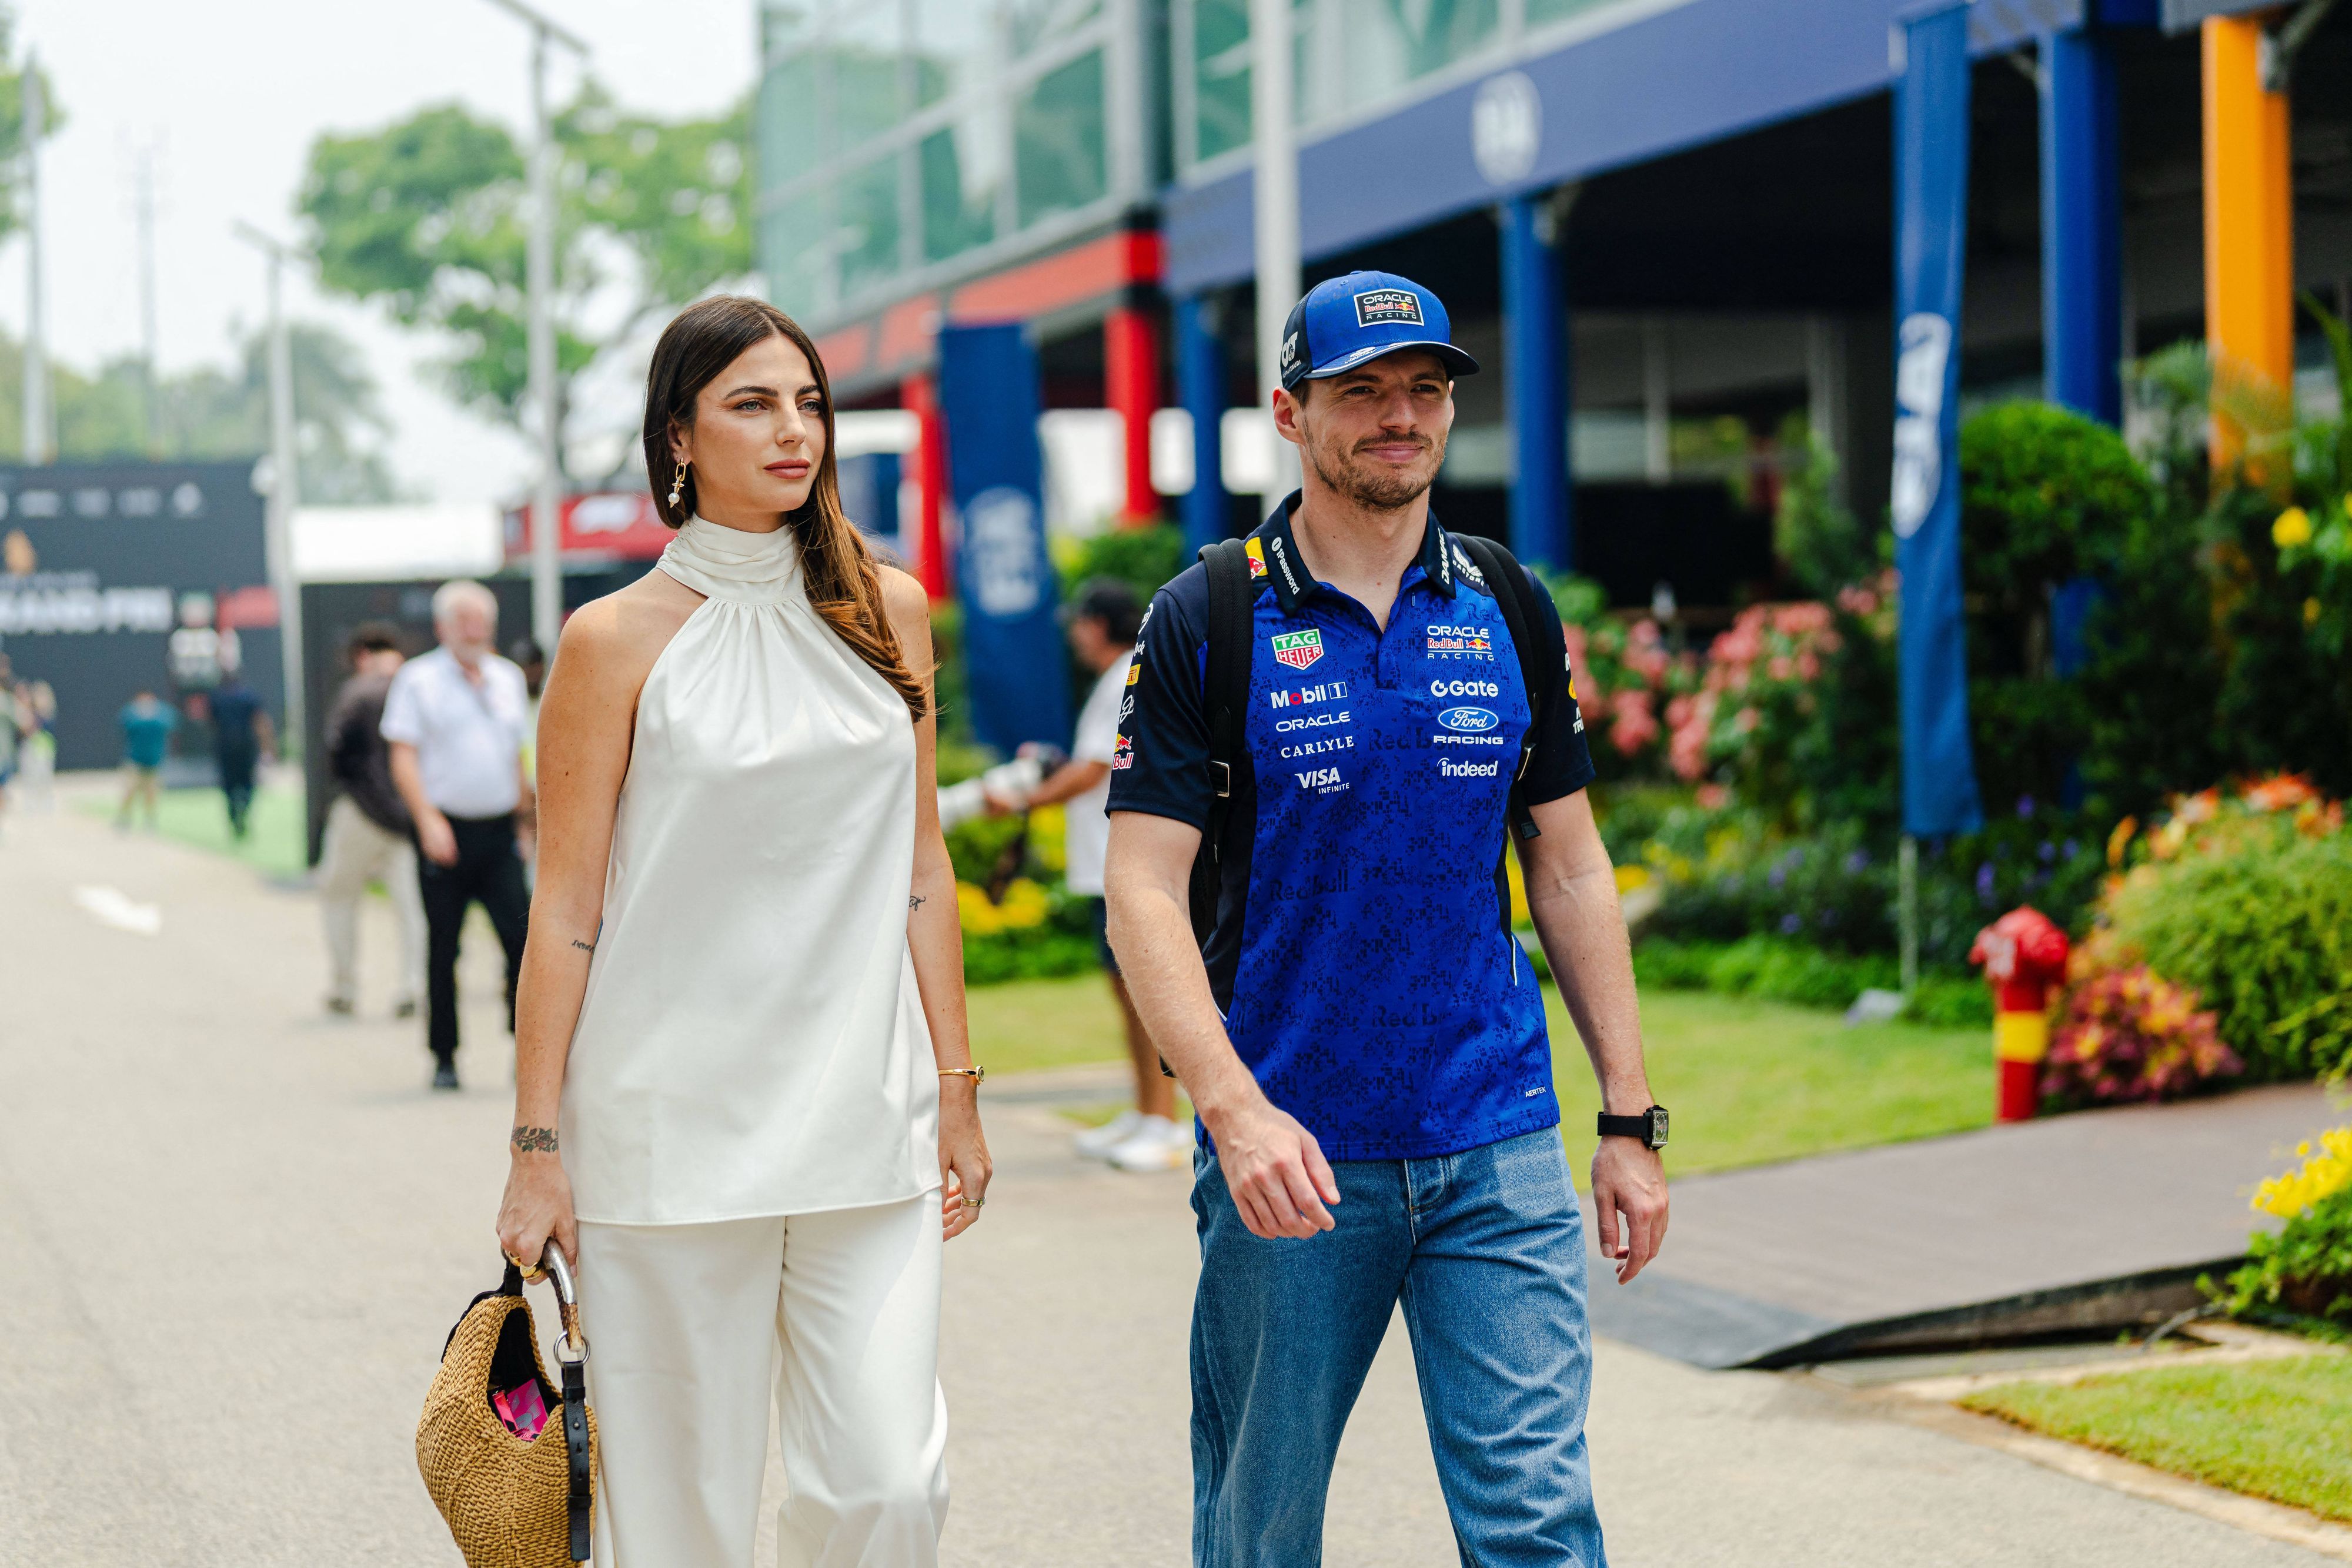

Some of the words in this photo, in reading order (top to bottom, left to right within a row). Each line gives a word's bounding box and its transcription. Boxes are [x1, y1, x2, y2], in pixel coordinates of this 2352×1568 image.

[1363, 293, 1413, 305] ORACLE
[1364, 304, 1379, 313] Red
[1379, 302, 1394, 311] Bull
[1366, 312, 1417, 320] RACING
[1438, 527, 1450, 585] DAMAC
[1276, 548, 1301, 596] 1Password
[1426, 625, 1490, 639] ORACLE
[1276, 633, 1317, 649] TAG
[1427, 637, 1446, 649] Red
[1445, 638, 1464, 650] Bull
[1278, 647, 1321, 667] HEUER
[1427, 653, 1495, 661] RACING
[1270, 684, 1327, 709] Mobil
[1333, 683, 1341, 698] 1
[1449, 680, 1499, 698] Gate
[1275, 711, 1351, 733] ORACLE
[1450, 710, 1488, 728] Ford
[1281, 735, 1354, 759] CARLYLE
[1433, 735, 1504, 745] RACING
[1112, 752, 1134, 770] Bull
[1441, 760, 1498, 777] indeed
[1294, 767, 1341, 789] VISA
[1318, 783, 1350, 794] INFINITE
[1525, 1086, 1546, 1098] AERTEK
